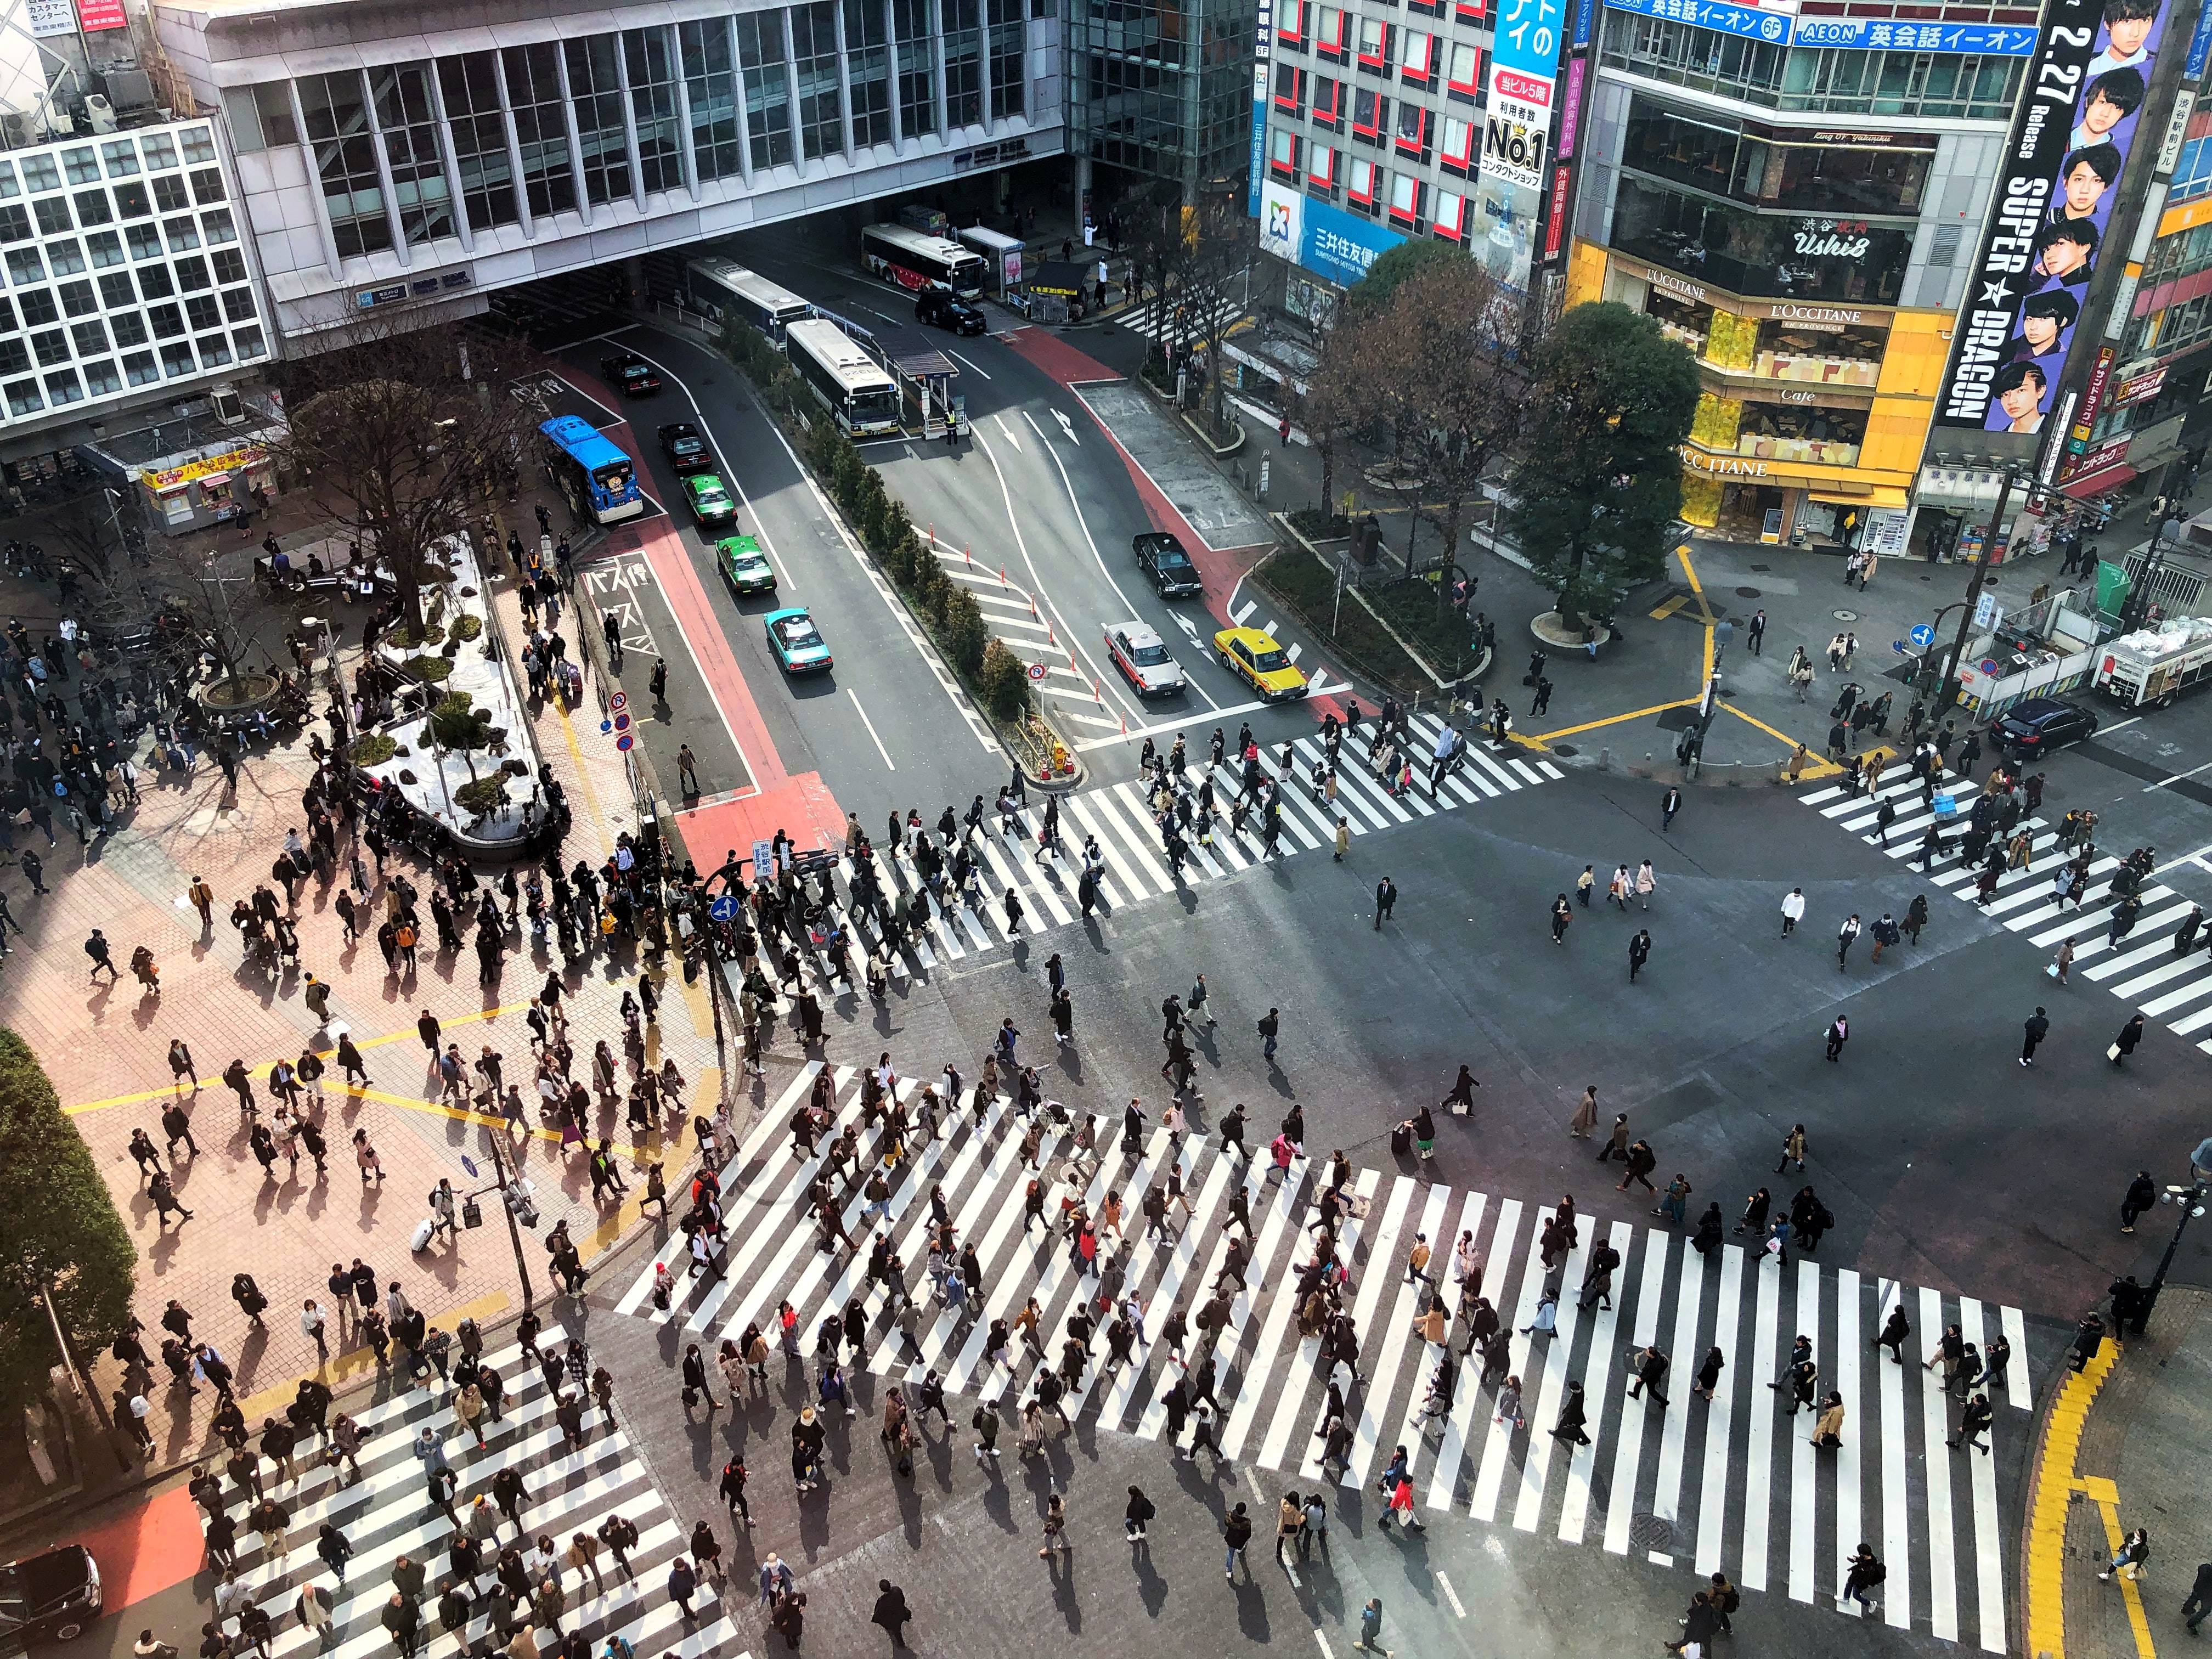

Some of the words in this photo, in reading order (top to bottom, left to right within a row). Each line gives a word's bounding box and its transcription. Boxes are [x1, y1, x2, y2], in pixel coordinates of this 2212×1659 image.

[29, 3, 66, 14] カスタマー
[31, 11, 69, 21] センターへ
[1651, 0, 1757, 31] 英会話イーオン
[1763, 20, 1780, 36] 6F
[1803, 24, 1856, 43] AEON
[1869, 24, 2032, 50] 英会話イーオン
[2036, 26, 2091, 104] 2.27
[1500, 76, 1547, 102] 当ビル5階
[1500, 101, 1536, 122] 利用者数
[1565, 77, 1579, 143] 品川美容外科
[1484, 114, 1545, 174] No.1
[2019, 105, 2051, 159] Release
[2162, 98, 2190, 166] 渋谷駅前ビル
[1561, 147, 1571, 156] 4F
[1482, 160, 1541, 187] コンタクトショップ
[1554, 168, 1567, 213] 外貨両替
[1985, 177, 2049, 274] SUPER
[1771, 304, 1861, 323] L'OCCITANE
[1799, 323, 1842, 331] PROVENCE
[1946, 309, 2012, 419] DRAGON
[1678, 443, 1768, 477] CCITANE
[760, 843, 771, 873] 渋谷駅前
